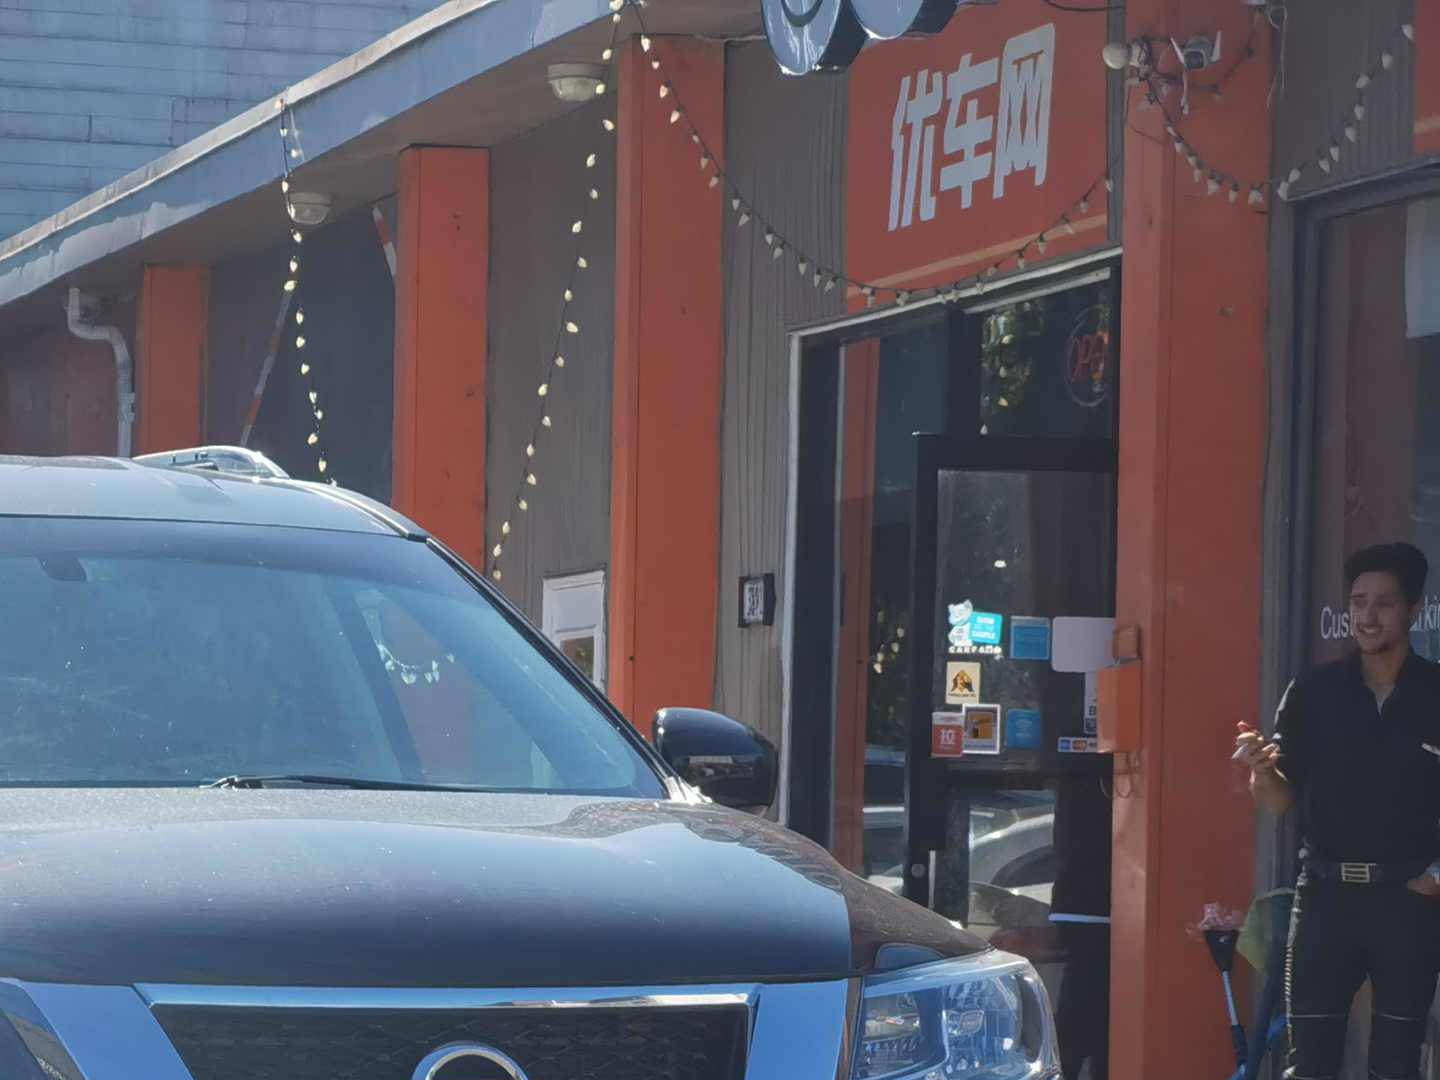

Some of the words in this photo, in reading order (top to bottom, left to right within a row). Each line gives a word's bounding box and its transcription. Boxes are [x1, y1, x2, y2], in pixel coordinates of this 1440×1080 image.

[888, 23, 1055, 231] 优车网
[1320, 606, 1354, 640] Cust
